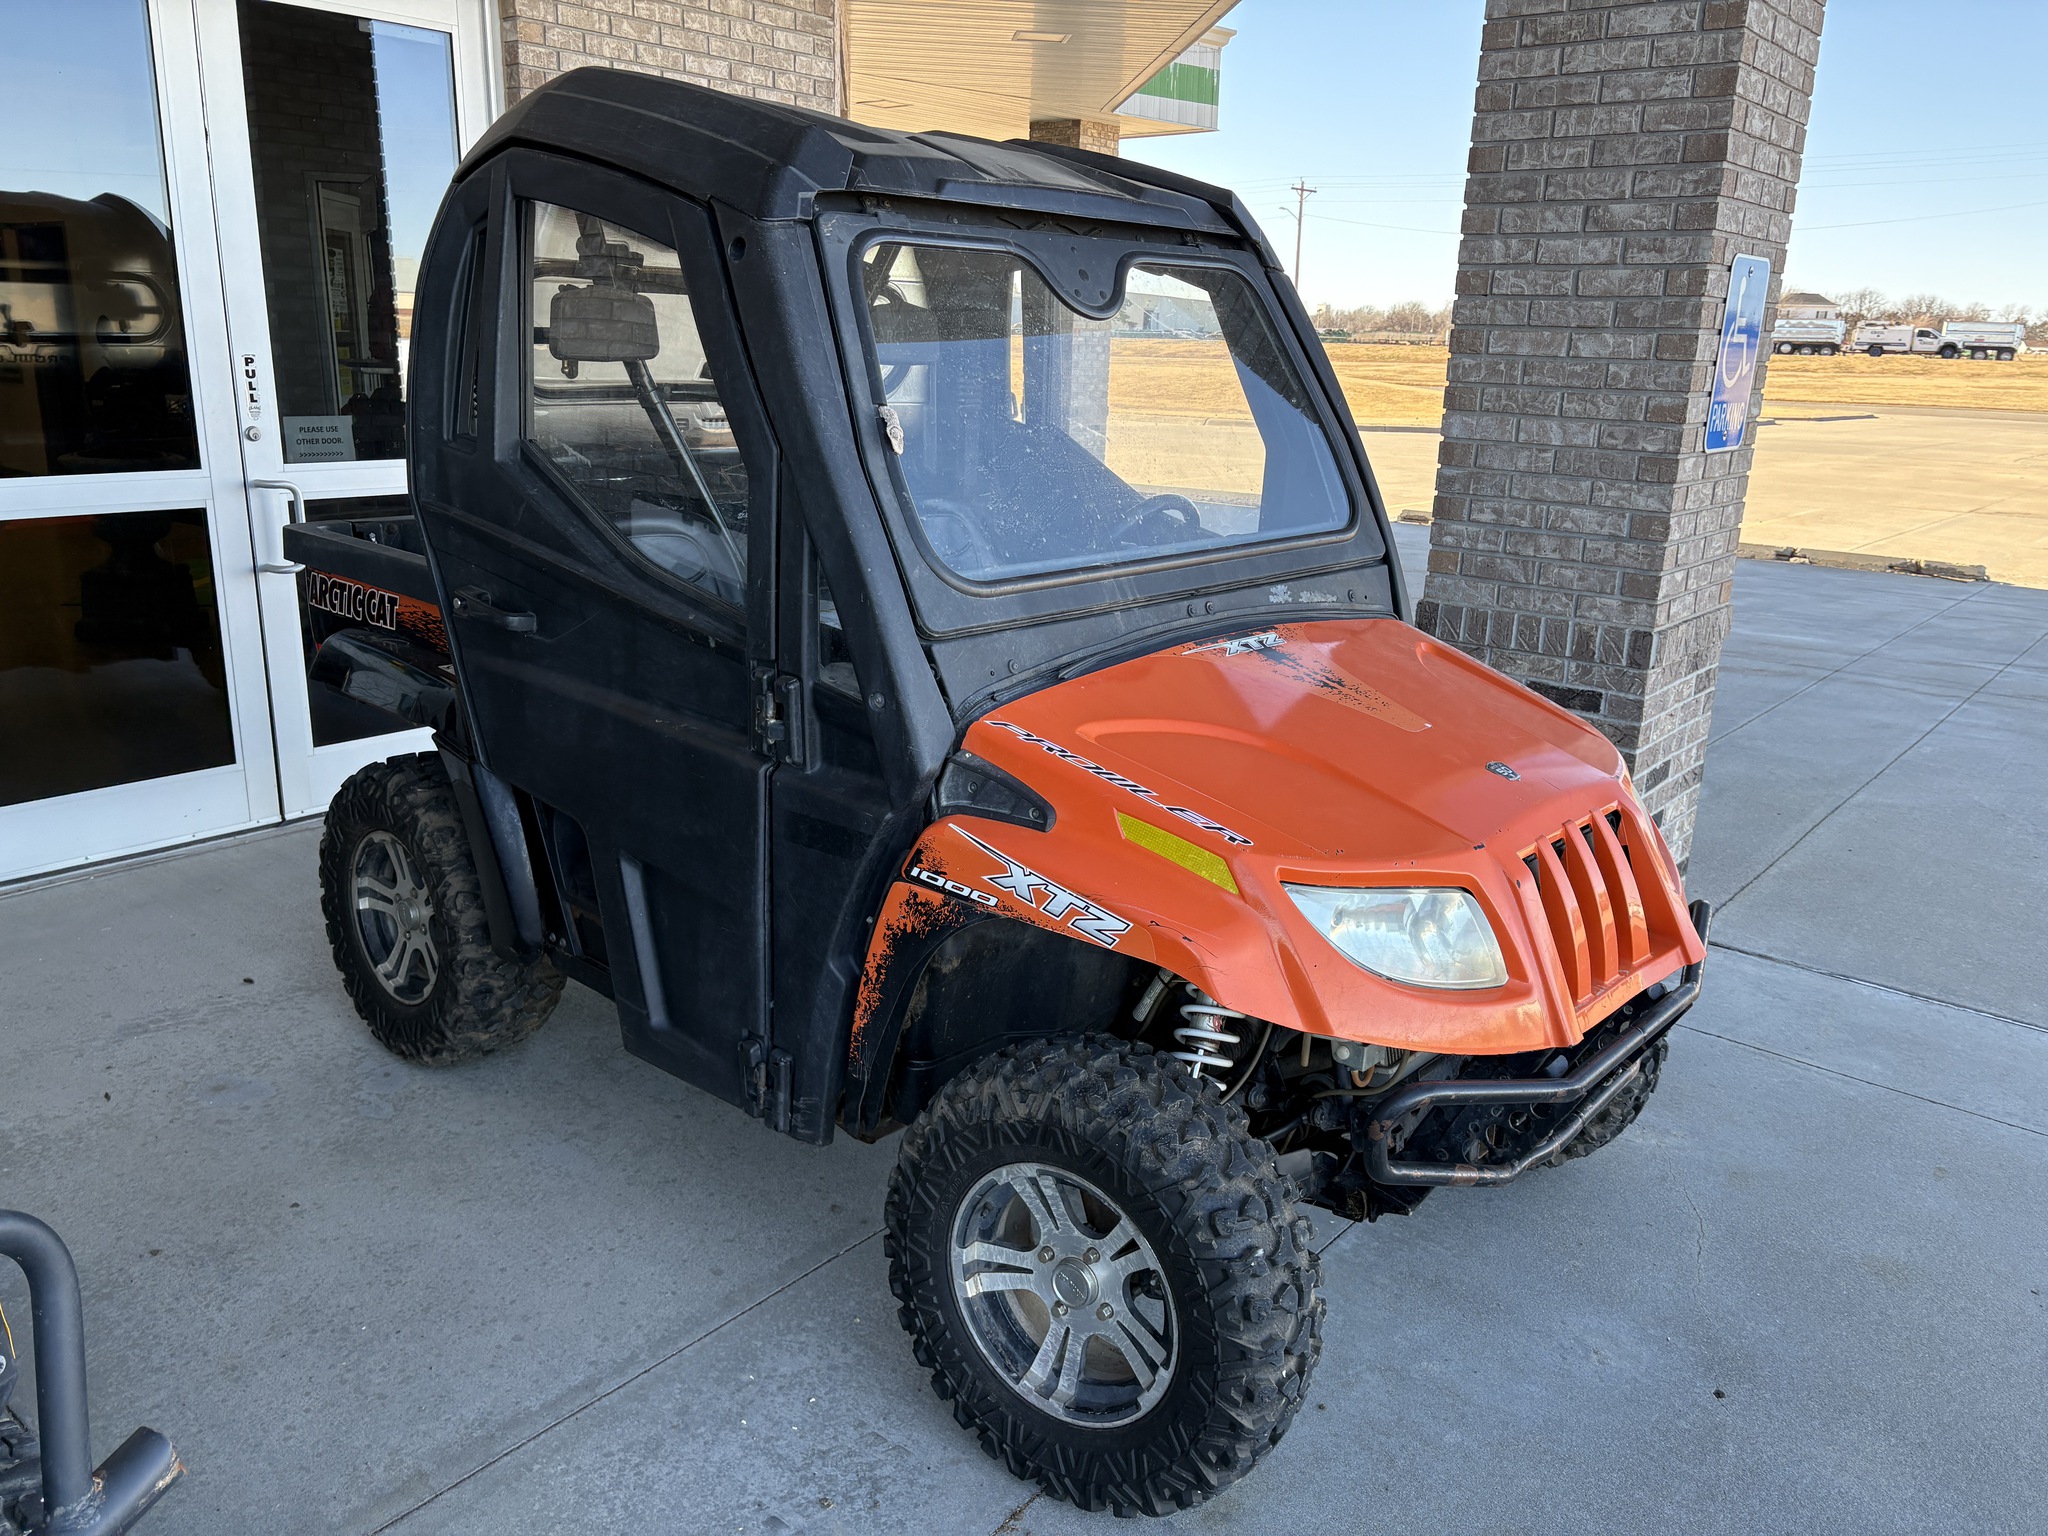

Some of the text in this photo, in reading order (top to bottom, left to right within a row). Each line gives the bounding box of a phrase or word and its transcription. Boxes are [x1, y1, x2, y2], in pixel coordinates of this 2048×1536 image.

[244, 357, 258, 403] PULL
[1709, 402, 1745, 432] PARKING
[321, 437, 344, 445] DOOR.
[309, 572, 400, 631] ARCTIC CAT
[1181, 632, 1287, 657] XTZ
[984, 720, 1254, 846] PROWLER
[910, 866, 1000, 908] 1000
[948, 823, 1134, 949] XTZ
